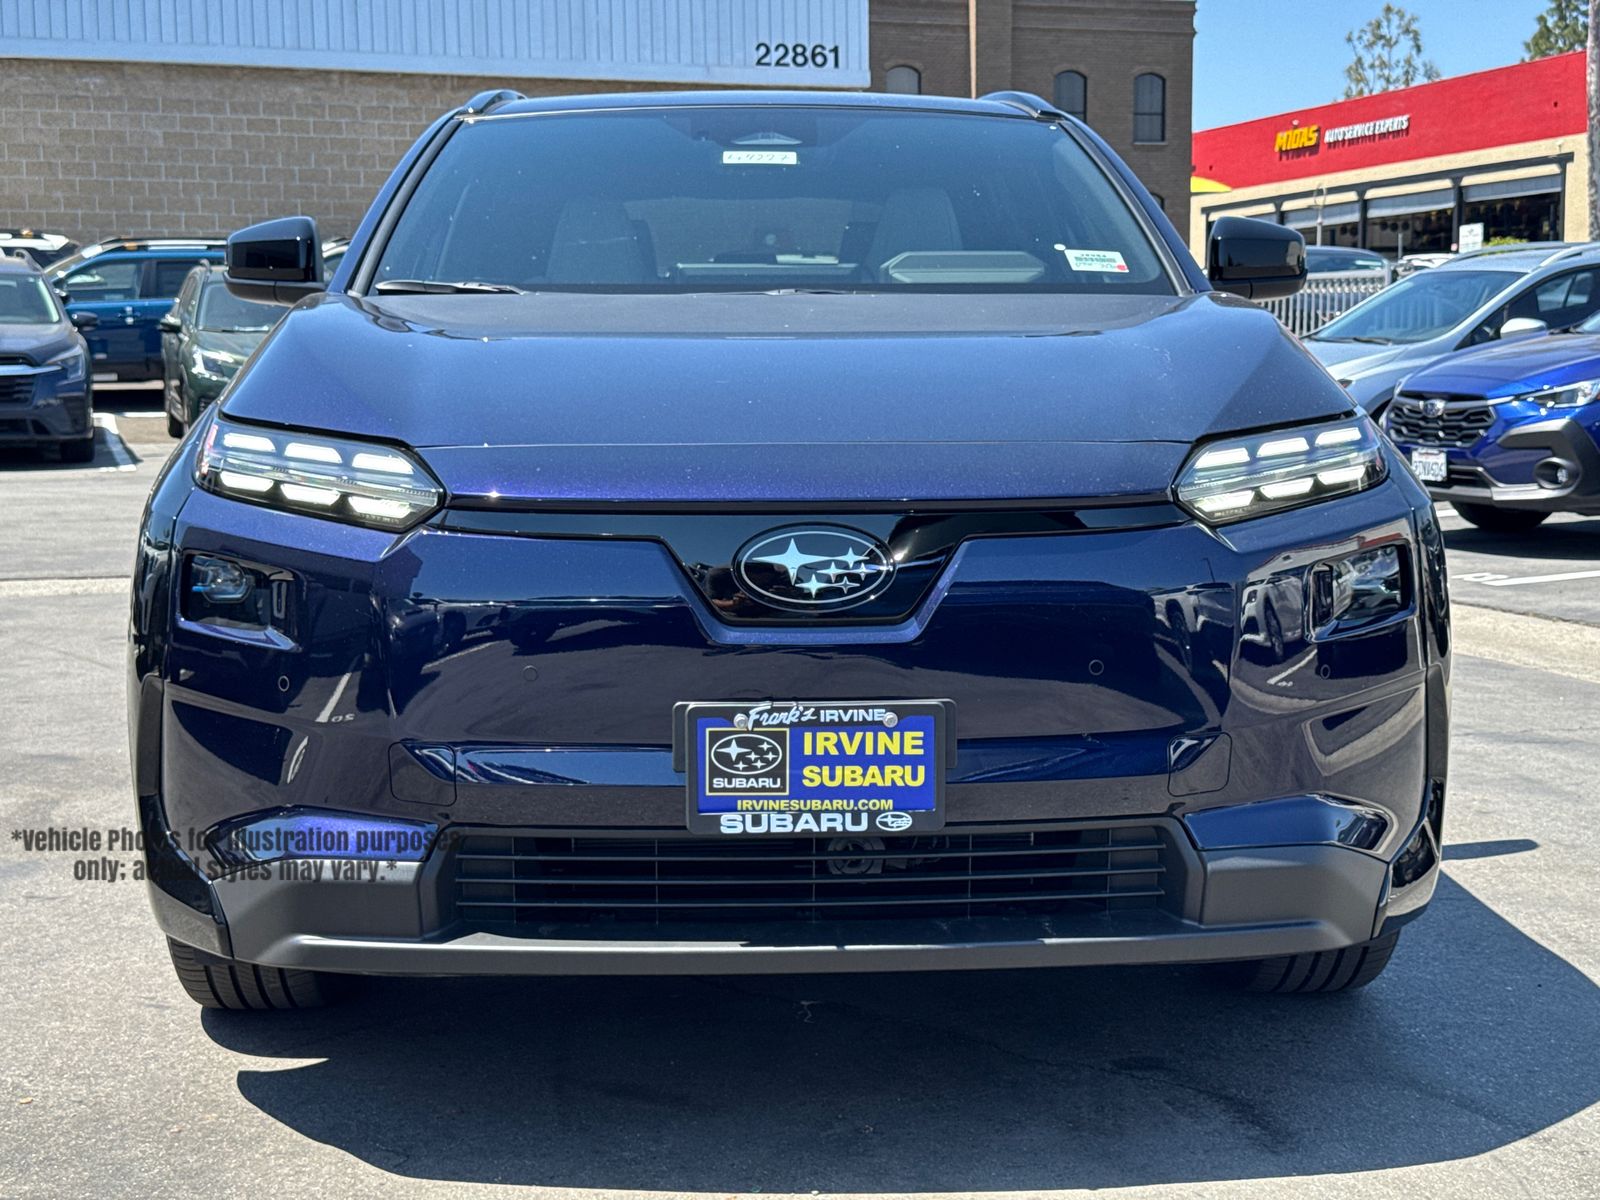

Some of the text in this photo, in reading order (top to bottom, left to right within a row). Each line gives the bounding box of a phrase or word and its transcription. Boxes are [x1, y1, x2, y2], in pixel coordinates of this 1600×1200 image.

[755, 42, 840, 69] 22861
[748, 701, 886, 731] Frank's IRVINE
[803, 731, 924, 756] IRVINE
[712, 777, 781, 789] SUBARU
[802, 765, 926, 787] SUBARU
[737, 799, 894, 811] IRVINESUBARU.COM
[720, 812, 868, 834] SUBARU
